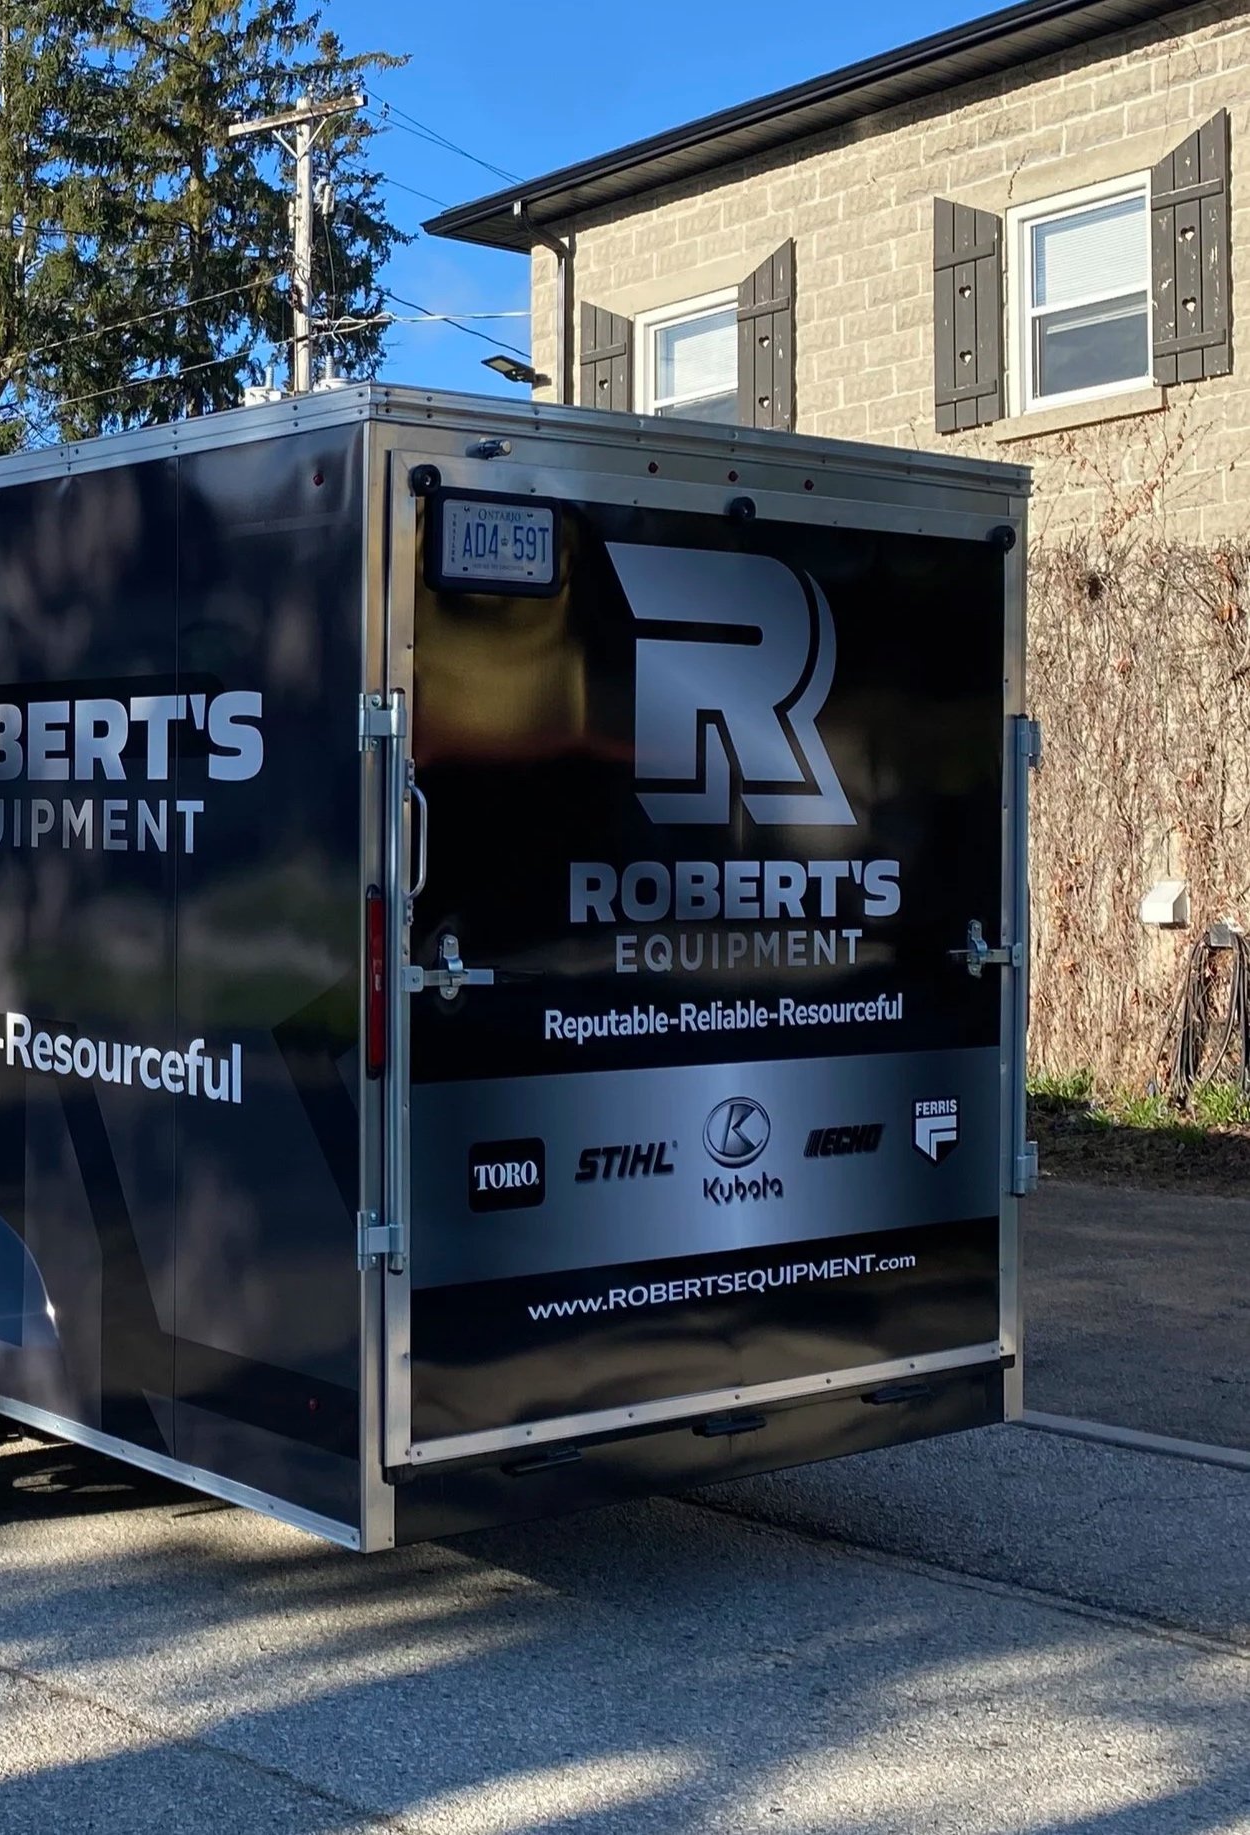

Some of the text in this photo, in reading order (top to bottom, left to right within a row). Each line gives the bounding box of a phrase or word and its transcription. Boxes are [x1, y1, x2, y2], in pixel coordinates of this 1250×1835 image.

[514, 525, 549, 563] 59T
[569, 859, 902, 924] ROBERT'S
[616, 929, 863, 974] EQUIPMENT
[544, 992, 903, 1045] Reputable-Reliable-Resourceful
[915, 1099, 958, 1116] FERRIS
[474, 1160, 538, 1191] TORO
[575, 1142, 674, 1181] STIHL
[703, 1172, 784, 1205] Kubota
[527, 1253, 916, 1321] www.ROBERTSEQUIPMENT.com
